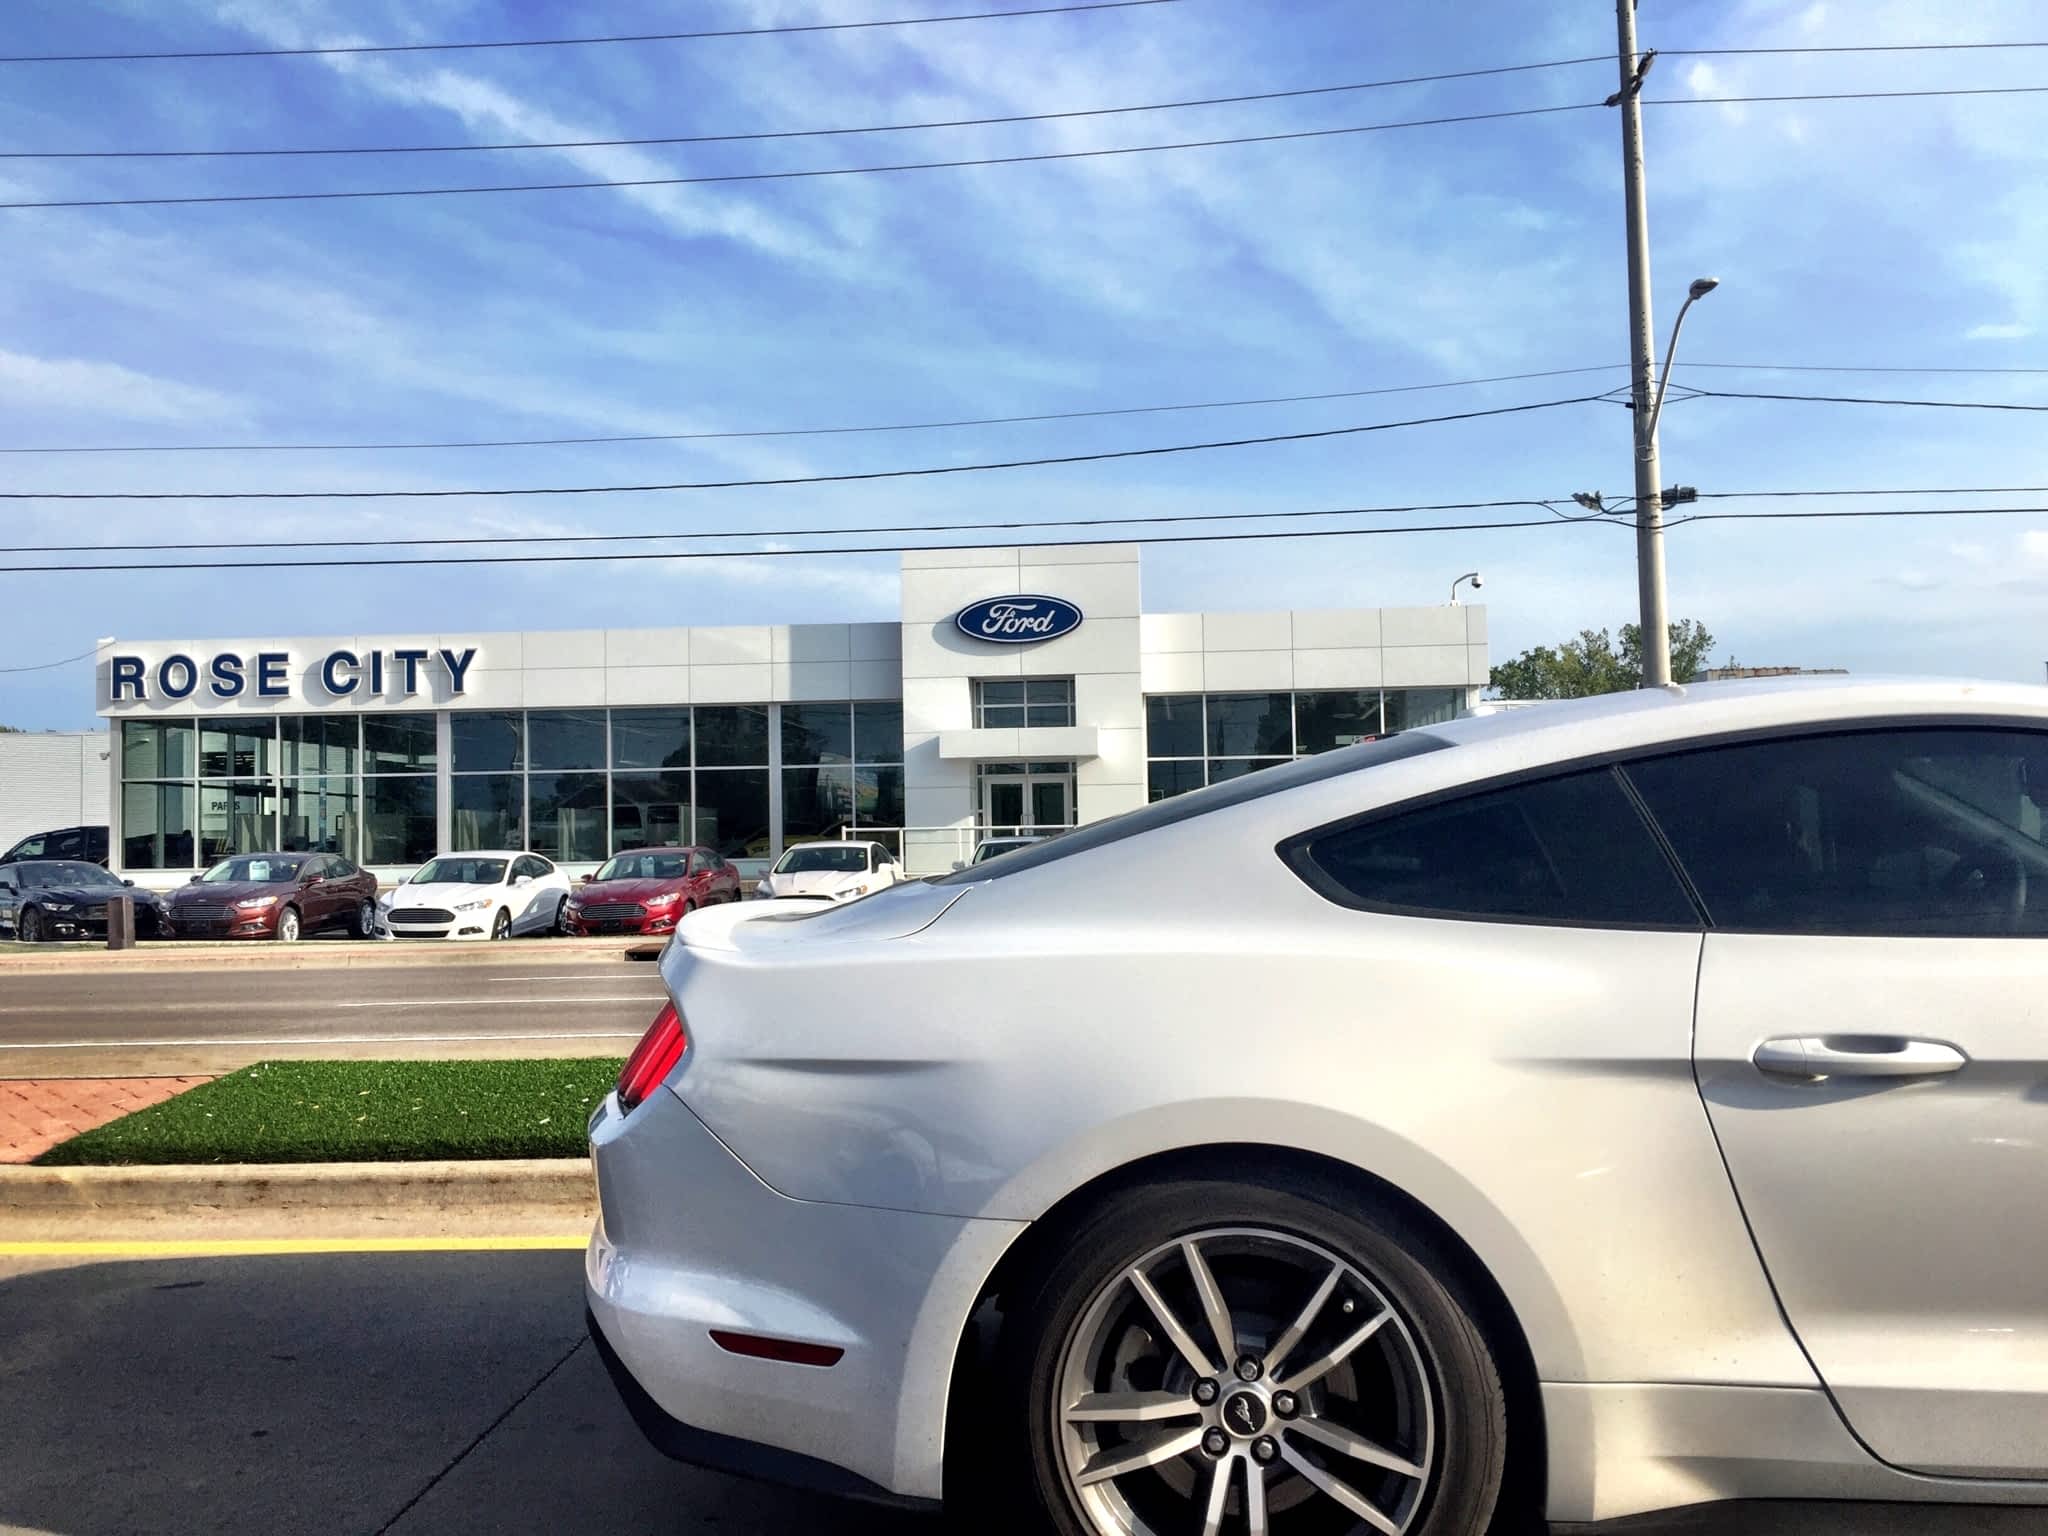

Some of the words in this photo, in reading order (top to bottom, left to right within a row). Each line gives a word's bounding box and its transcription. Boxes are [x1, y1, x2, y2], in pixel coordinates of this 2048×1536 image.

[982, 603, 1056, 633] Ford
[111, 652, 291, 700] ROSE
[322, 648, 478, 697] CITY
[211, 801, 241, 811] PARS
